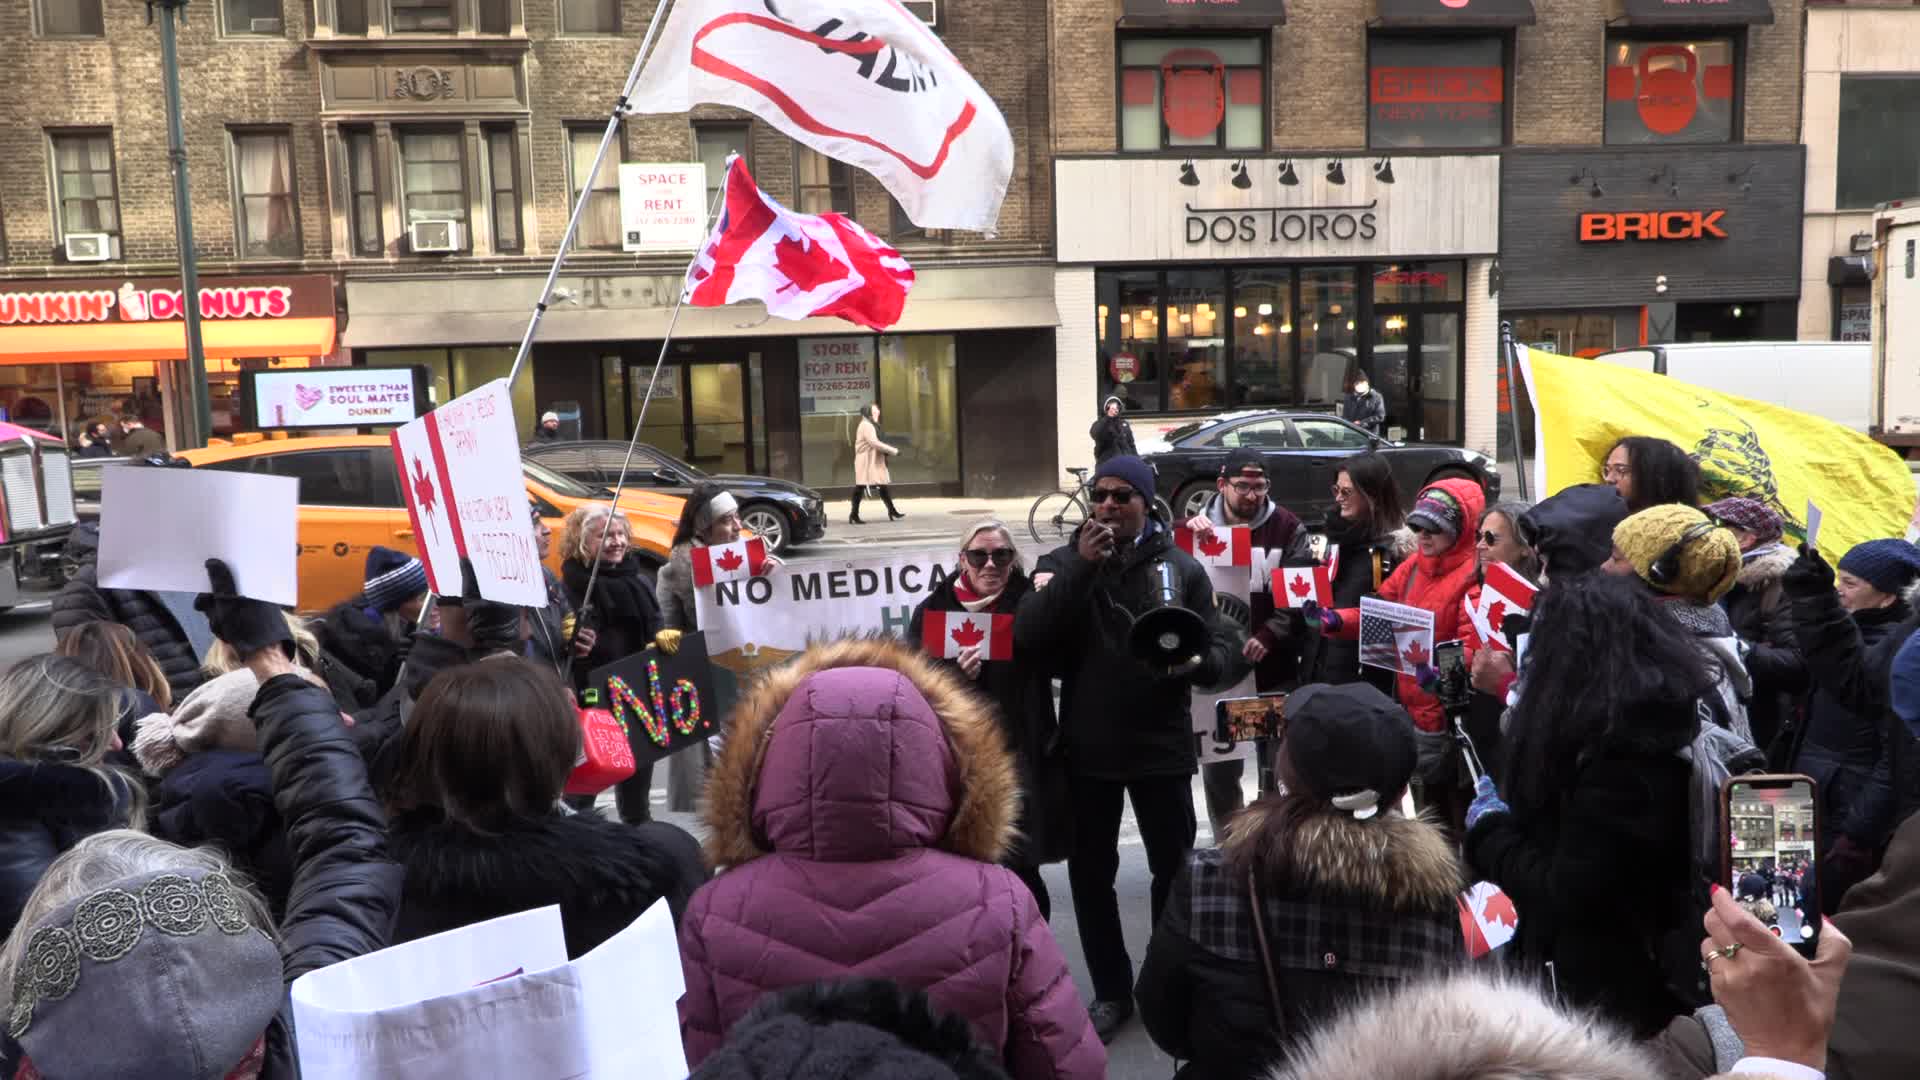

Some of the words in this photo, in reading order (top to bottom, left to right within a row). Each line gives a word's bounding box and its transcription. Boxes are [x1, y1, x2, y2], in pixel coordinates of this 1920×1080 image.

[639, 173, 687, 185] SPACE
[644, 199, 684, 210] RENT
[1186, 215, 1256, 243] DOS
[1580, 211, 1728, 240] BRICK
[0, 291, 114, 322] UNKIN'
[1841, 309, 1871, 321] SPA
[1843, 332, 1871, 341] REN
[812, 343, 861, 356] STORE
[805, 361, 832, 376] FOR
[835, 361, 868, 374] RENT
[329, 385, 376, 393] SWEETER
[380, 383, 409, 391] THAN
[329, 395, 364, 404] SOUL
[367, 393, 410, 403] MATES
[715, 576, 773, 606] NO
[791, 563, 948, 602] MEDICA
[608, 659, 711, 747] No.
